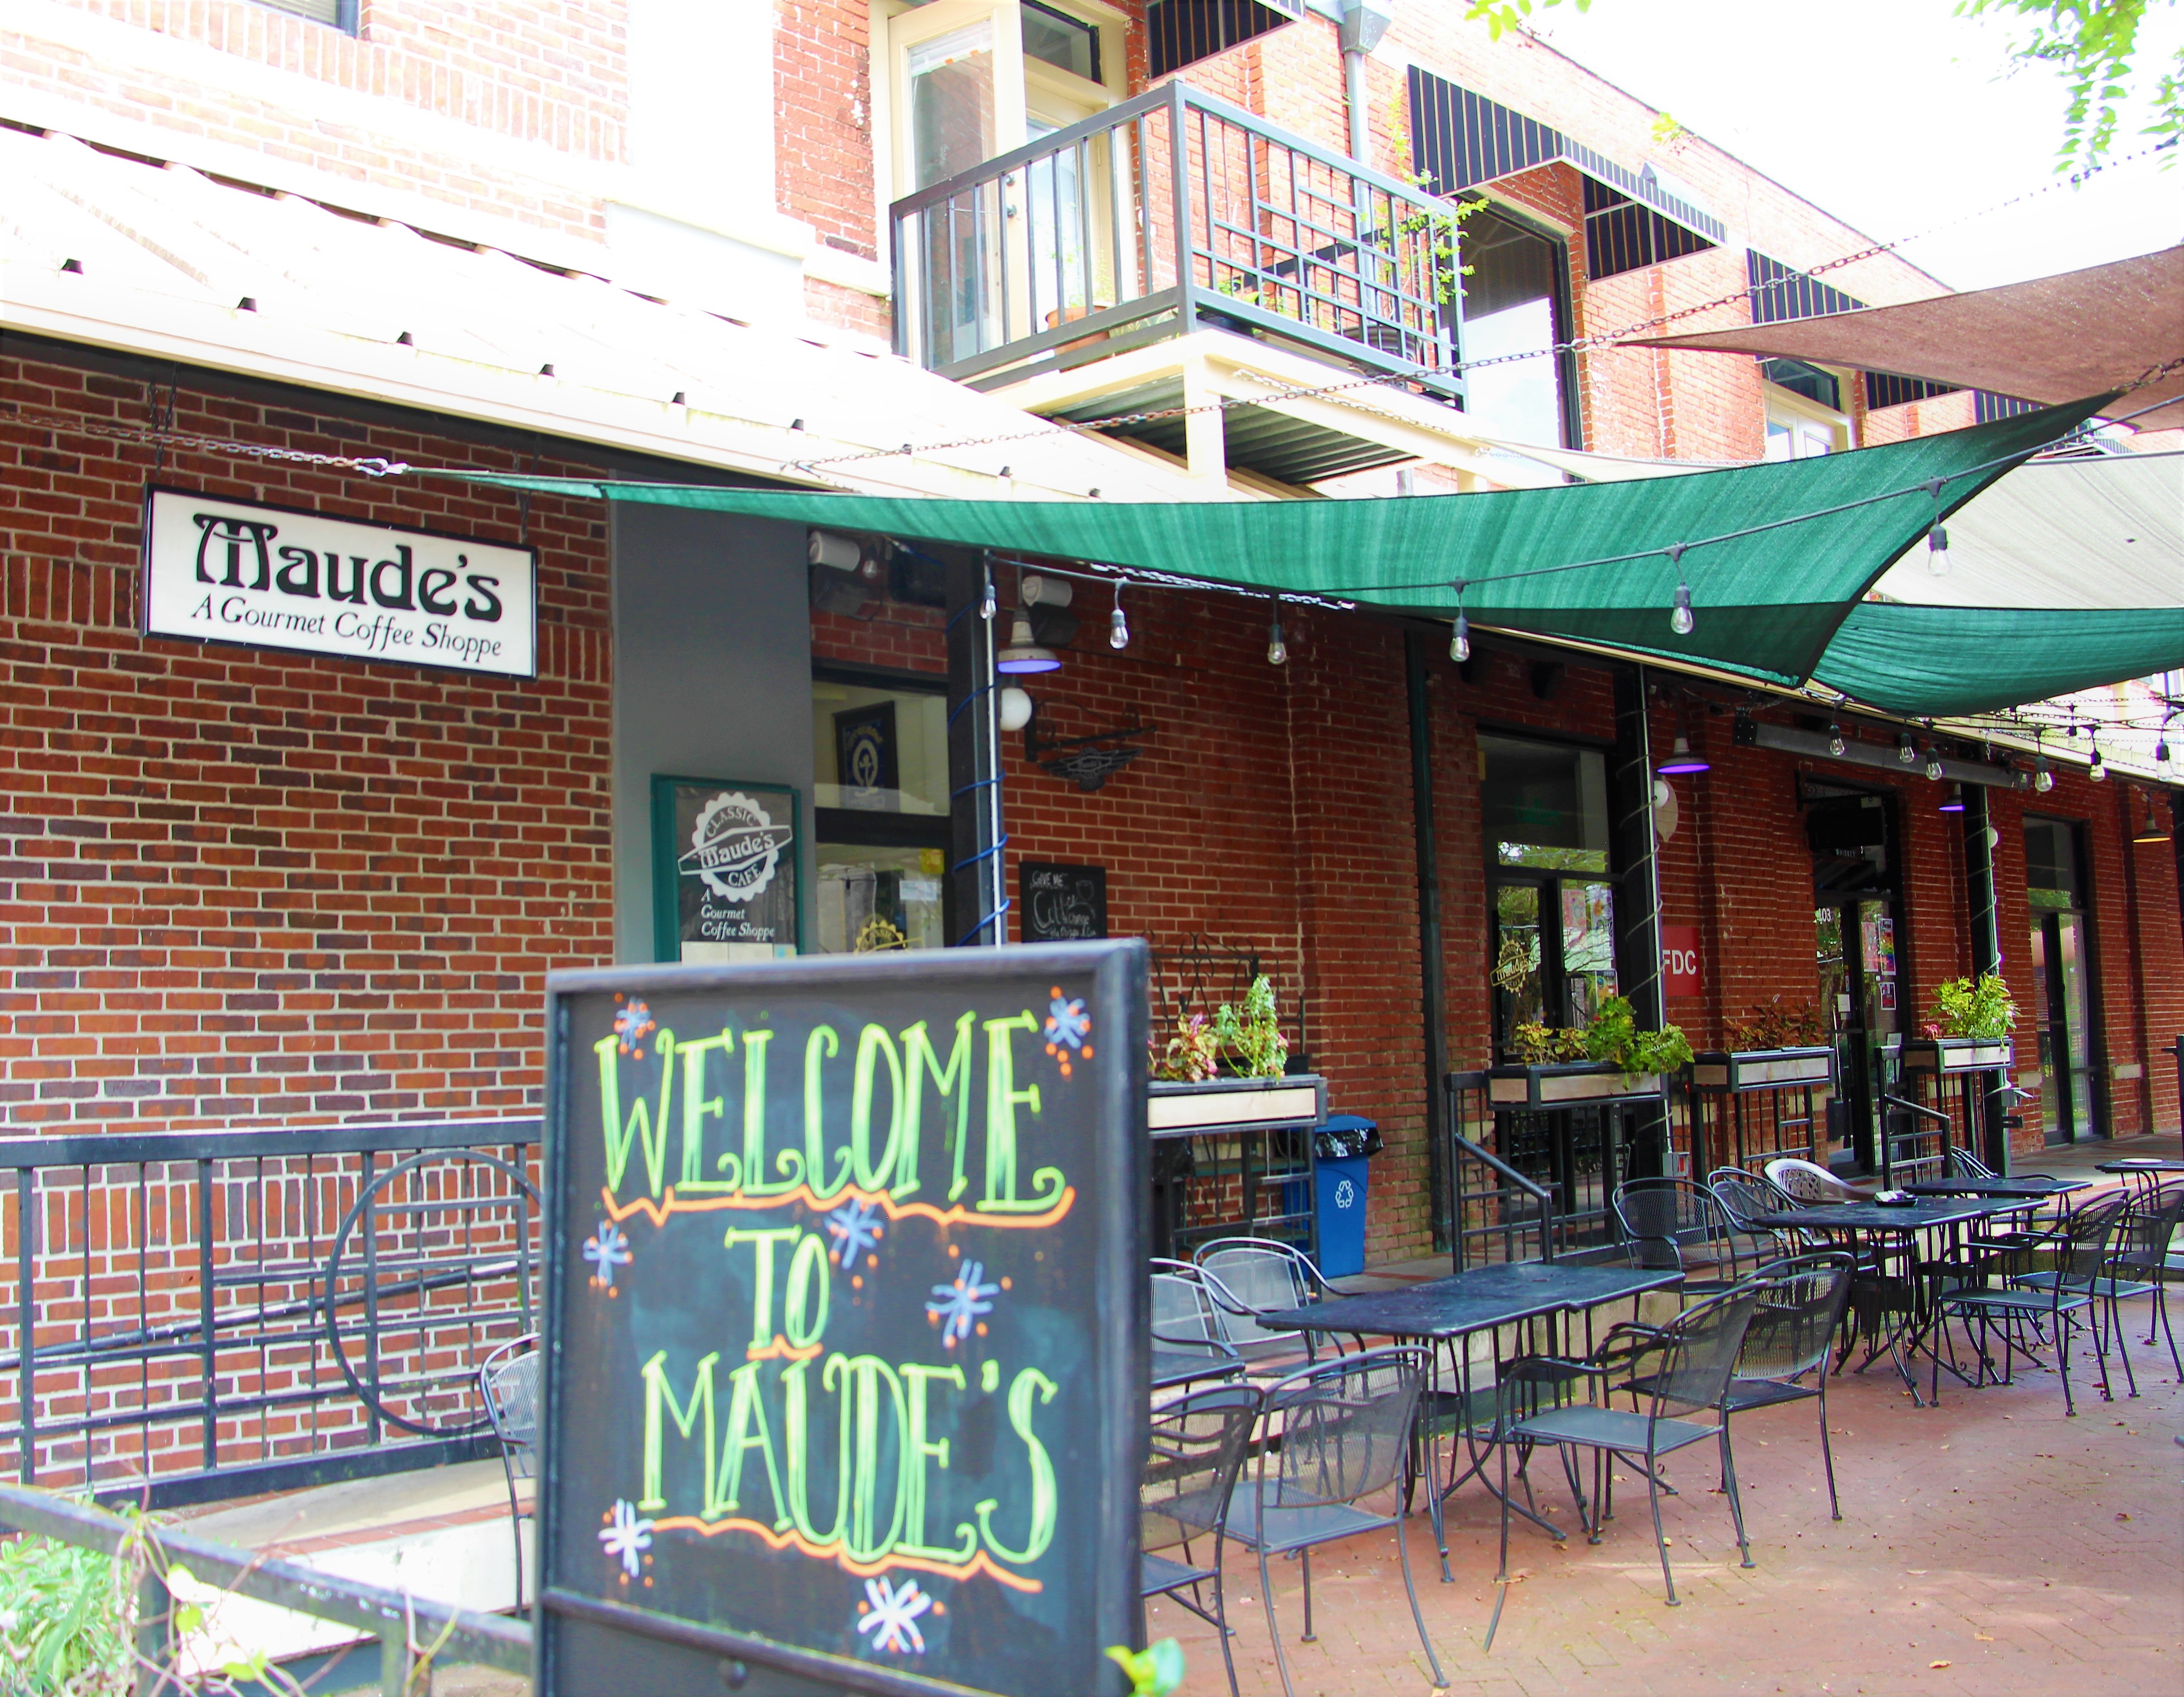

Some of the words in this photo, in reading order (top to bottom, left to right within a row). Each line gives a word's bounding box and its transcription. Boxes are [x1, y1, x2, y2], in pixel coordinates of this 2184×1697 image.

[193, 513, 502, 622] Maude's
[192, 592, 212, 619] A
[221, 596, 325, 634] Gourmet
[335, 612, 414, 653] Coffee
[421, 623, 502, 664] Shoppe
[706, 807, 756, 838] CLASSIC
[698, 832, 775, 869] Maude's
[727, 863, 761, 887] CAFE
[701, 888, 711, 902] A
[701, 904, 746, 920] Gourmet
[701, 921, 737, 941] Coffee
[739, 921, 775, 942] Shoppe
[1662, 949, 1697, 975] FDC
[594, 1008, 1067, 1212] WELCOME
[724, 1226, 830, 1352] TO
[637, 1350, 1059, 1564] MAUDE'S
